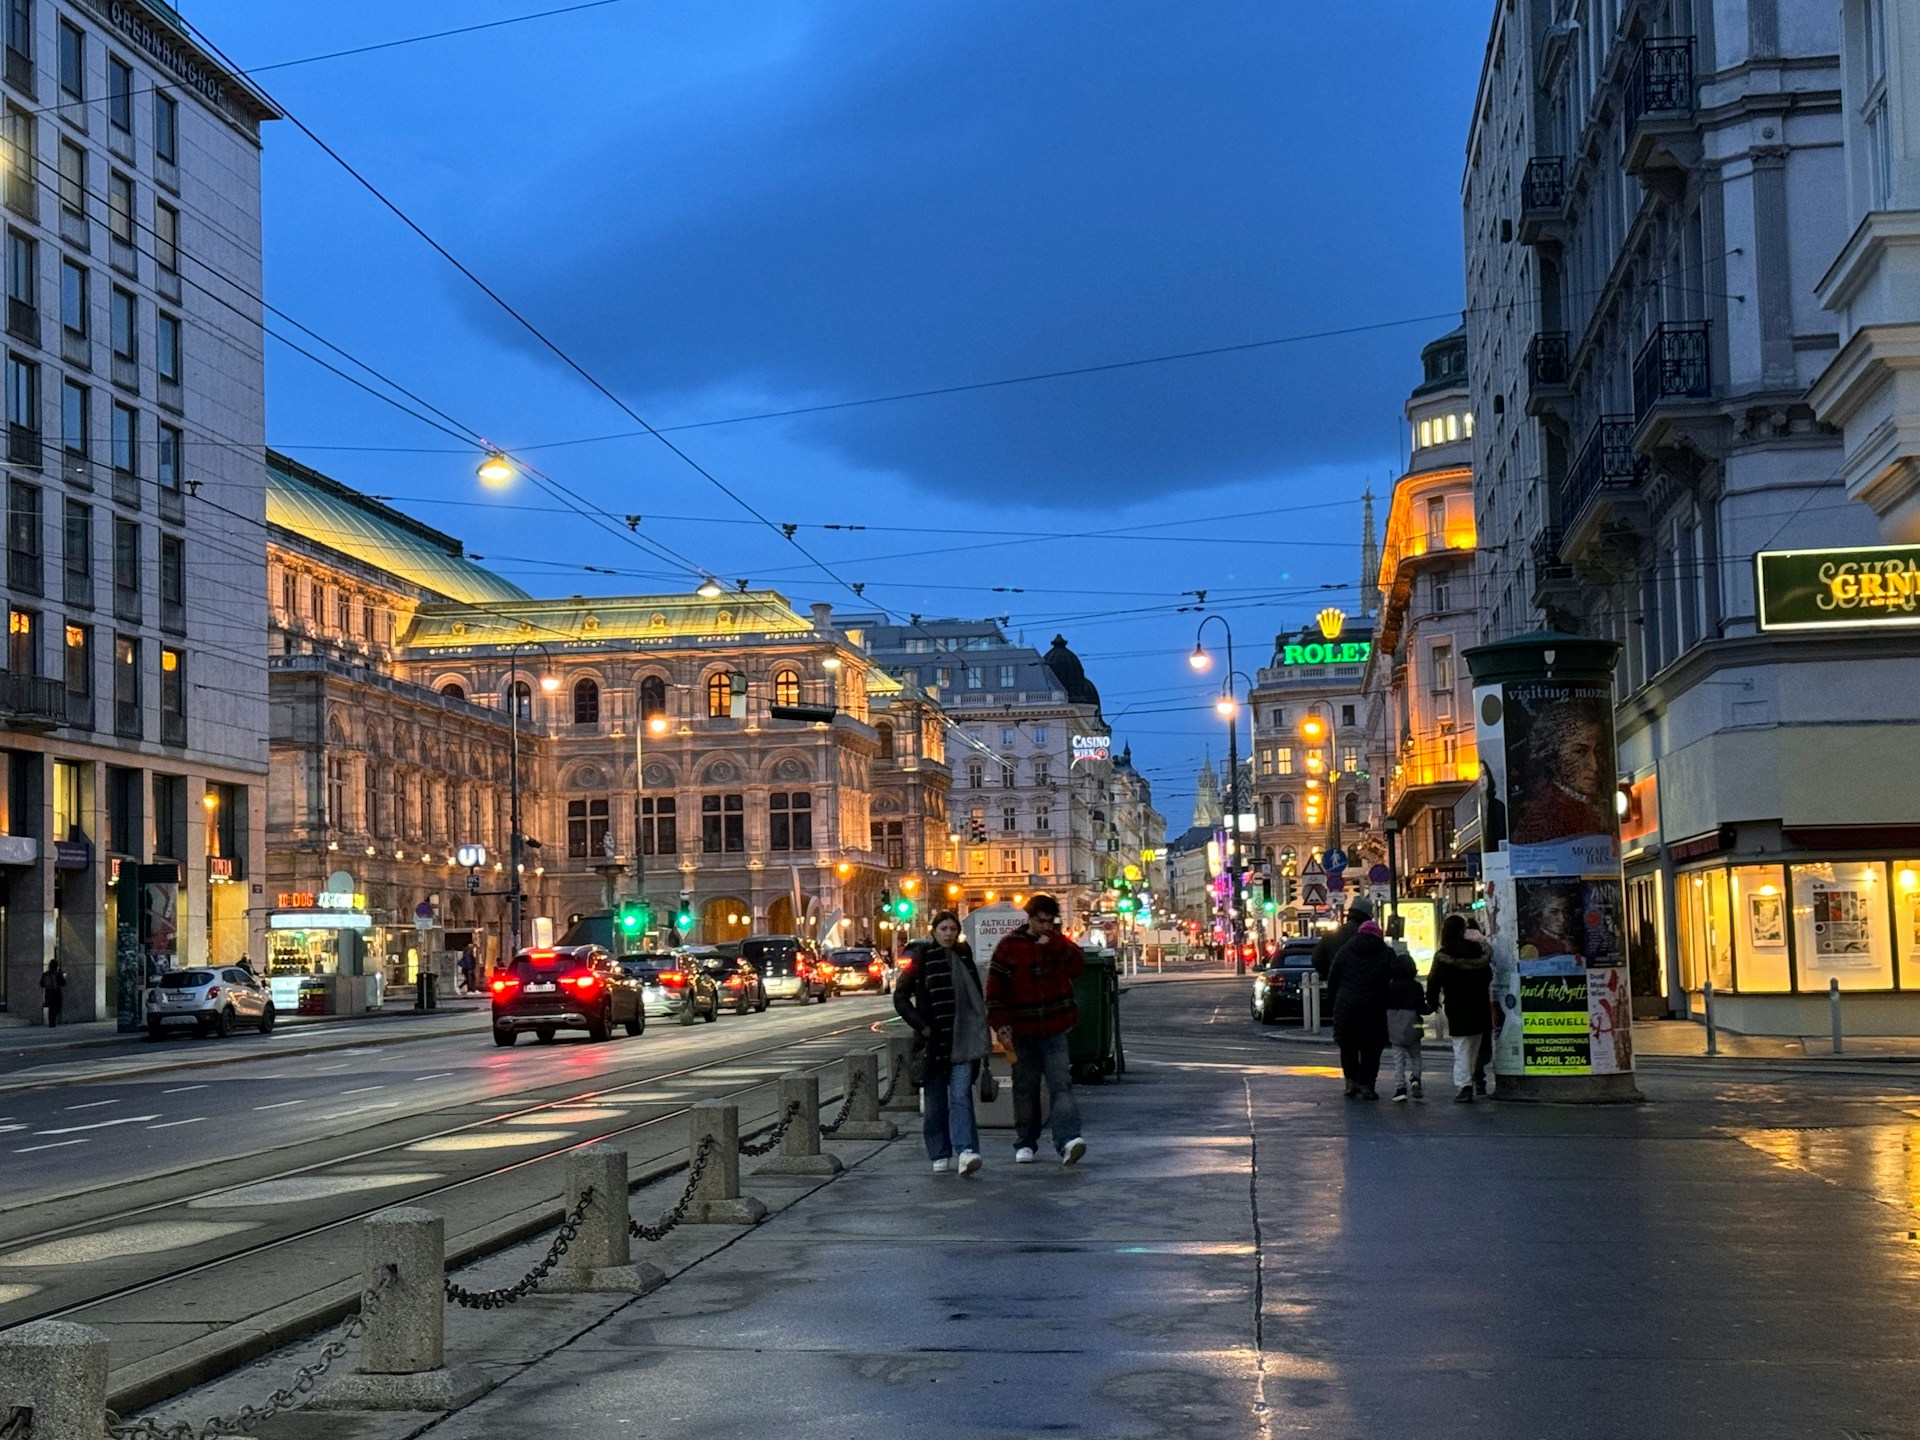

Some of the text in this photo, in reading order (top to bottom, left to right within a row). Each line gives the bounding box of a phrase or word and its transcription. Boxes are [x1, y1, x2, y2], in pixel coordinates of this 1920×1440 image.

[111, 2, 225, 101] OPERNRINGHOF
[1508, 685, 1570, 703] visiting
[1072, 735, 1110, 749] CASINO
[292, 892, 313, 907] DOG
[981, 919, 1027, 927] ALTKLEIDE
[1524, 1018, 1587, 1026] FAREWELL
[1526, 1056, 1535, 1065] 8.
[1536, 1056, 1563, 1065] APRIL
[1564, 1056, 1587, 1065] 2024
